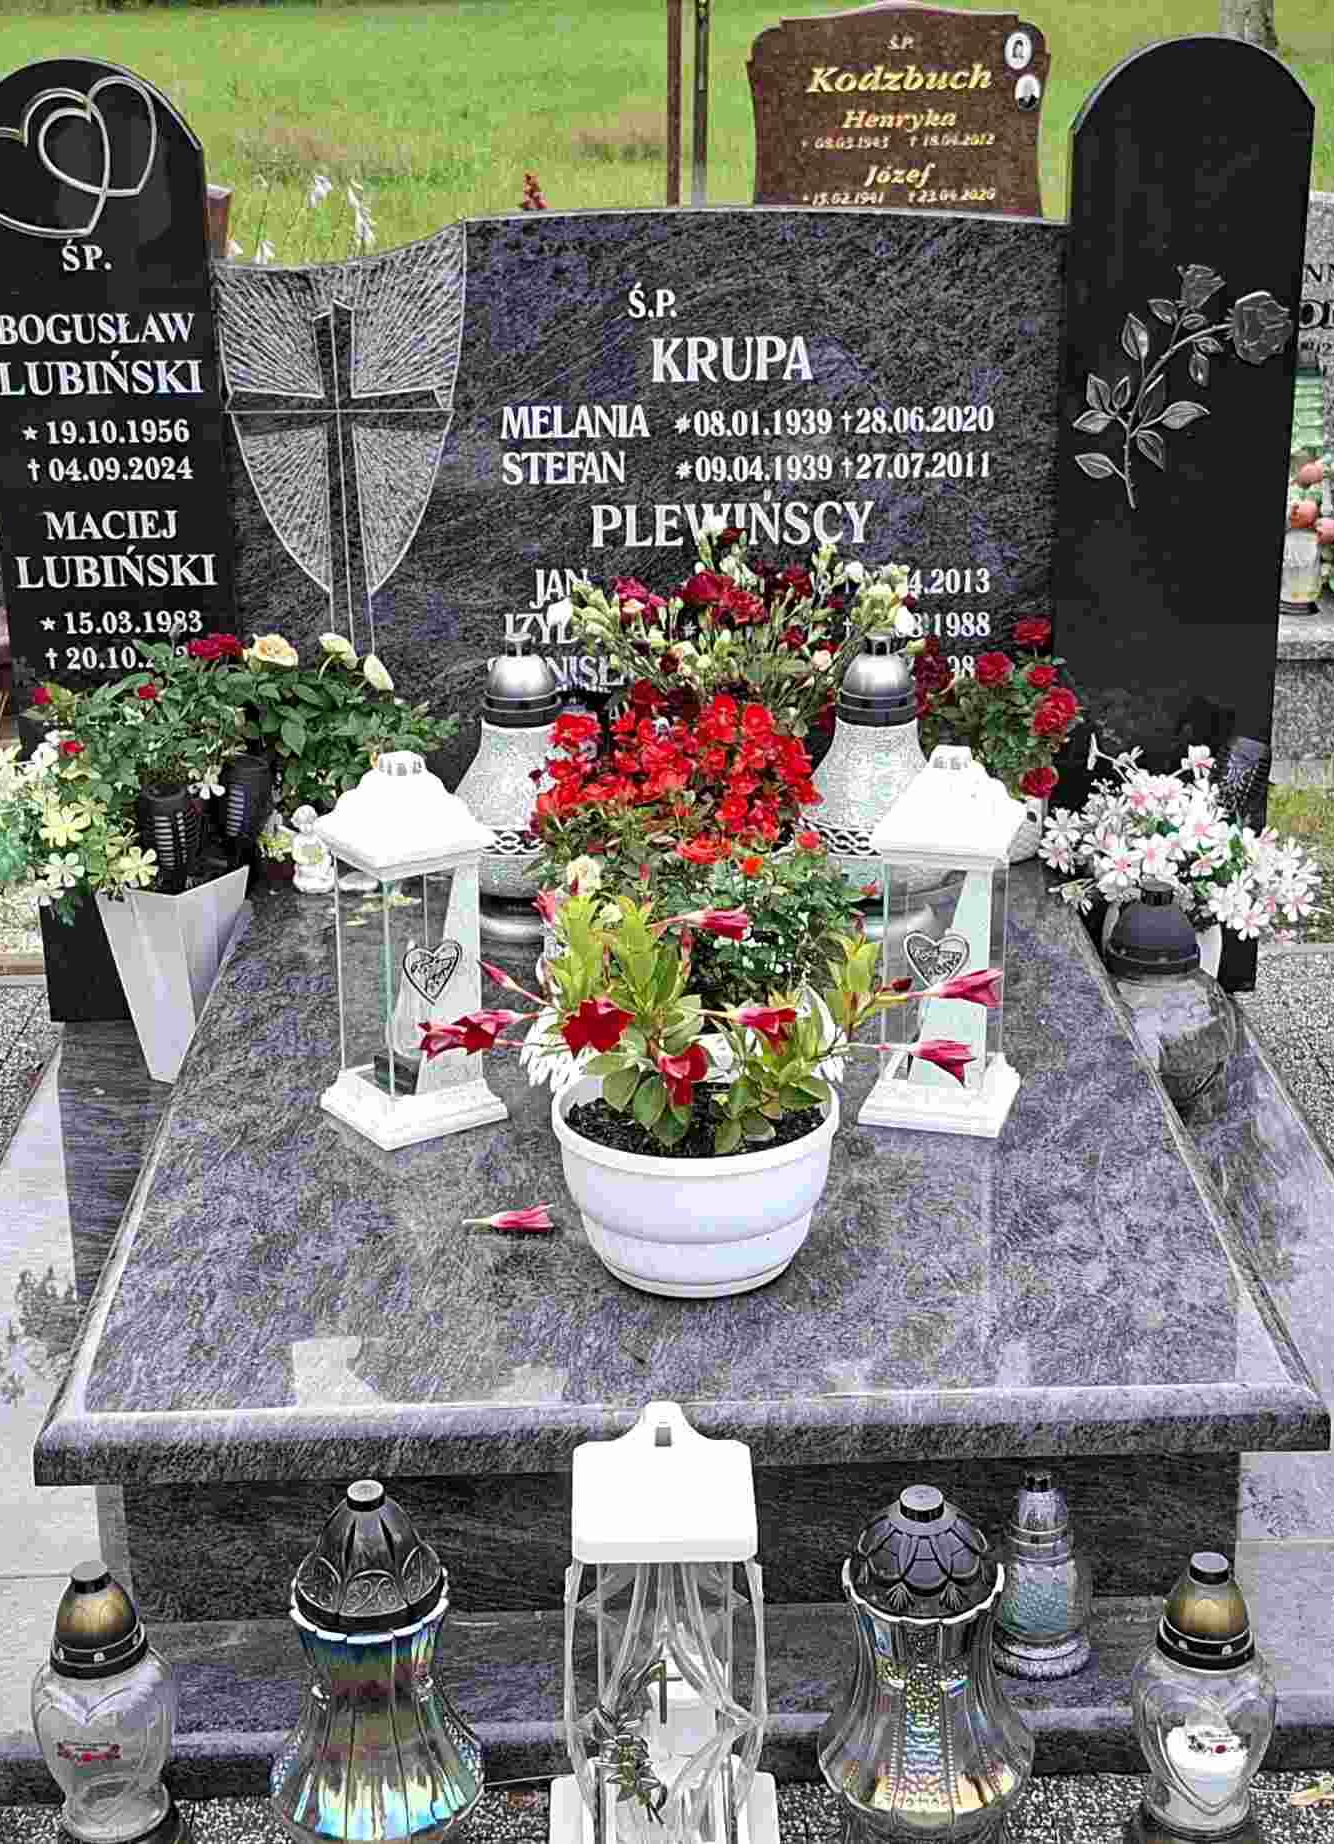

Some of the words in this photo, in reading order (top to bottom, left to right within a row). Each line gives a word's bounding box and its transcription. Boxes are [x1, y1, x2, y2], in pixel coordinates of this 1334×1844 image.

[805, 63, 992, 93] Kodzbuch
[843, 109, 957, 131] Henryka
[864, 162, 936, 188] Józef
[628, 281, 678, 318] Ś.P.
[651, 335, 814, 383] KRUPA
[45, 418, 190, 445] 19.10.1956
[500, 404, 651, 439] MELANIA
[48, 455, 194, 482] 04.09.2024
[501, 451, 626, 485] STEFAN
[43, 510, 179, 540] MACIEJ
[590, 488, 875, 548] PLEWIŃSCY
[15, 545, 219, 588] LUBIŃSKI
[64, 609, 204, 635] 15.03.1983
